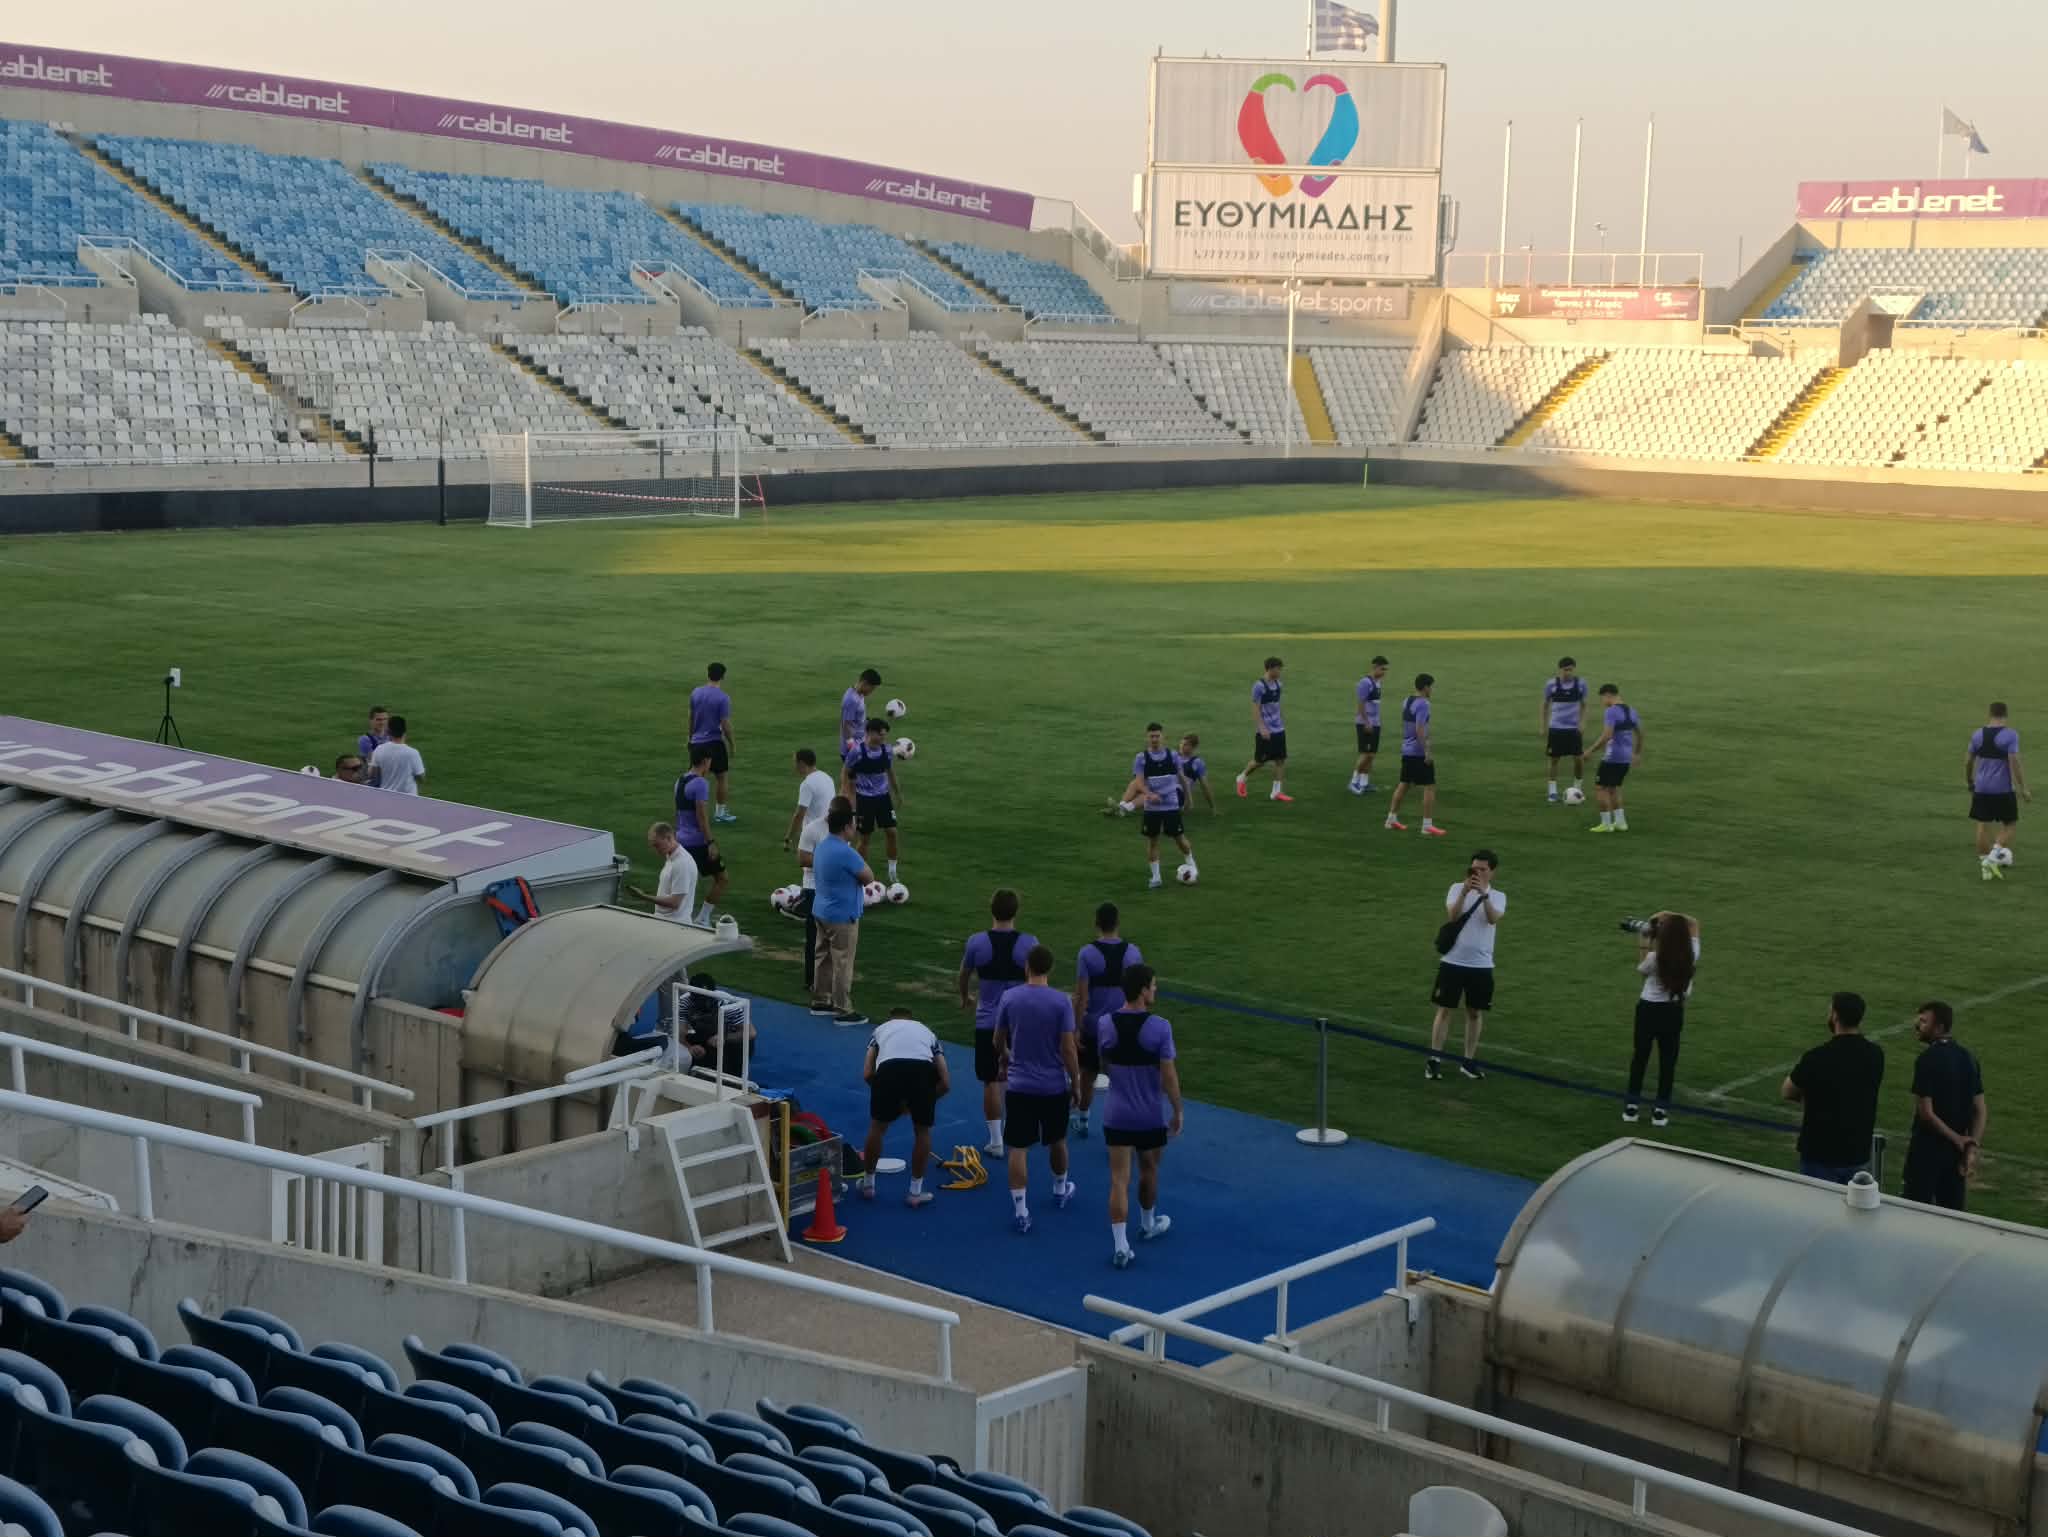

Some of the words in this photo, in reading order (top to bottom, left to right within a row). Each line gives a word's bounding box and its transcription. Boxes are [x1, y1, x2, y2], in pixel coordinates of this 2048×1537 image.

[0, 54, 112, 87] ablenet
[228, 82, 350, 114] cablenet
[459, 112, 573, 144] cablenet
[676, 143, 785, 175] cablenet
[885, 179, 992, 213] cablenet
[1852, 185, 2004, 213] cablenet
[1175, 200, 1413, 231] ΕΥΘΥΜΙΑΔΗΣ
[0, 747, 512, 863] cablenet
